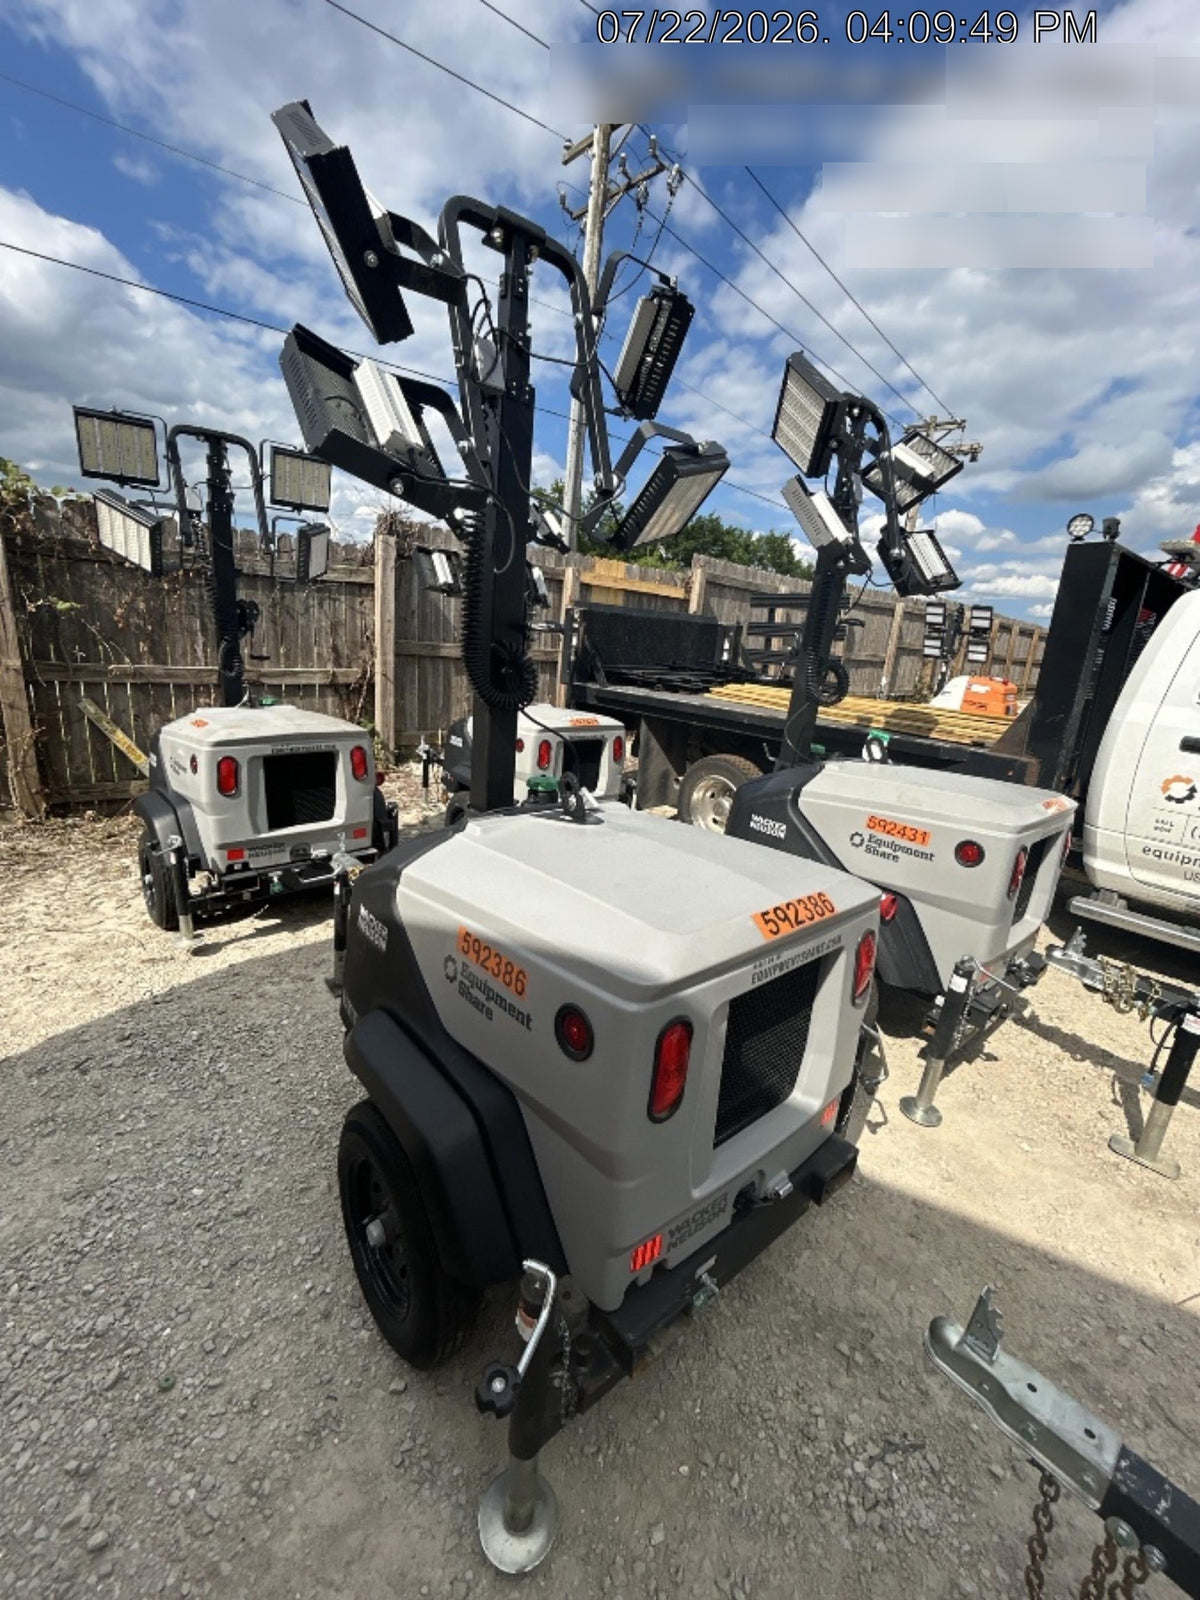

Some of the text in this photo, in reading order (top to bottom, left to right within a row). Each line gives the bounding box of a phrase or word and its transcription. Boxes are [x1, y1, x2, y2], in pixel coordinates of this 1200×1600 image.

[867, 816, 928, 844] 592431
[867, 834, 935, 862] Equipment
[865, 845, 899, 862] Share
[761, 892, 835, 935] 592386
[461, 931, 528, 996] 592386
[458, 981, 494, 1021] Share
[460, 960, 533, 1031] Equipment
